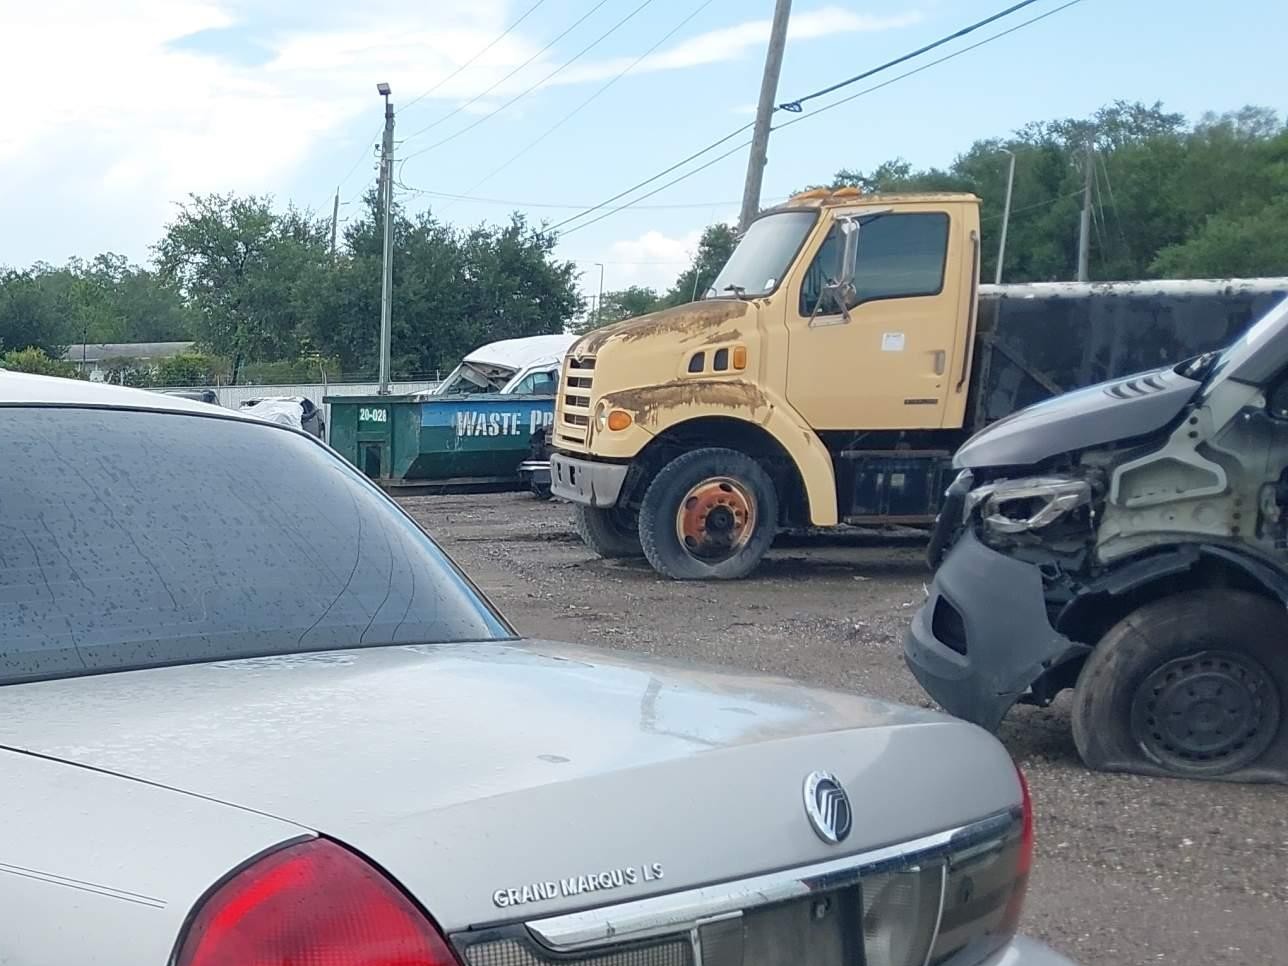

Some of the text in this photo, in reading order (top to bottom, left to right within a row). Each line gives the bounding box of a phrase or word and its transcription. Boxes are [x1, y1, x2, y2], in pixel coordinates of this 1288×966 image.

[360, 408, 387, 422] 20-028
[456, 411, 521, 437] WASTE
[493, 882, 558, 907] GRAND
[642, 862, 664, 881] LS
